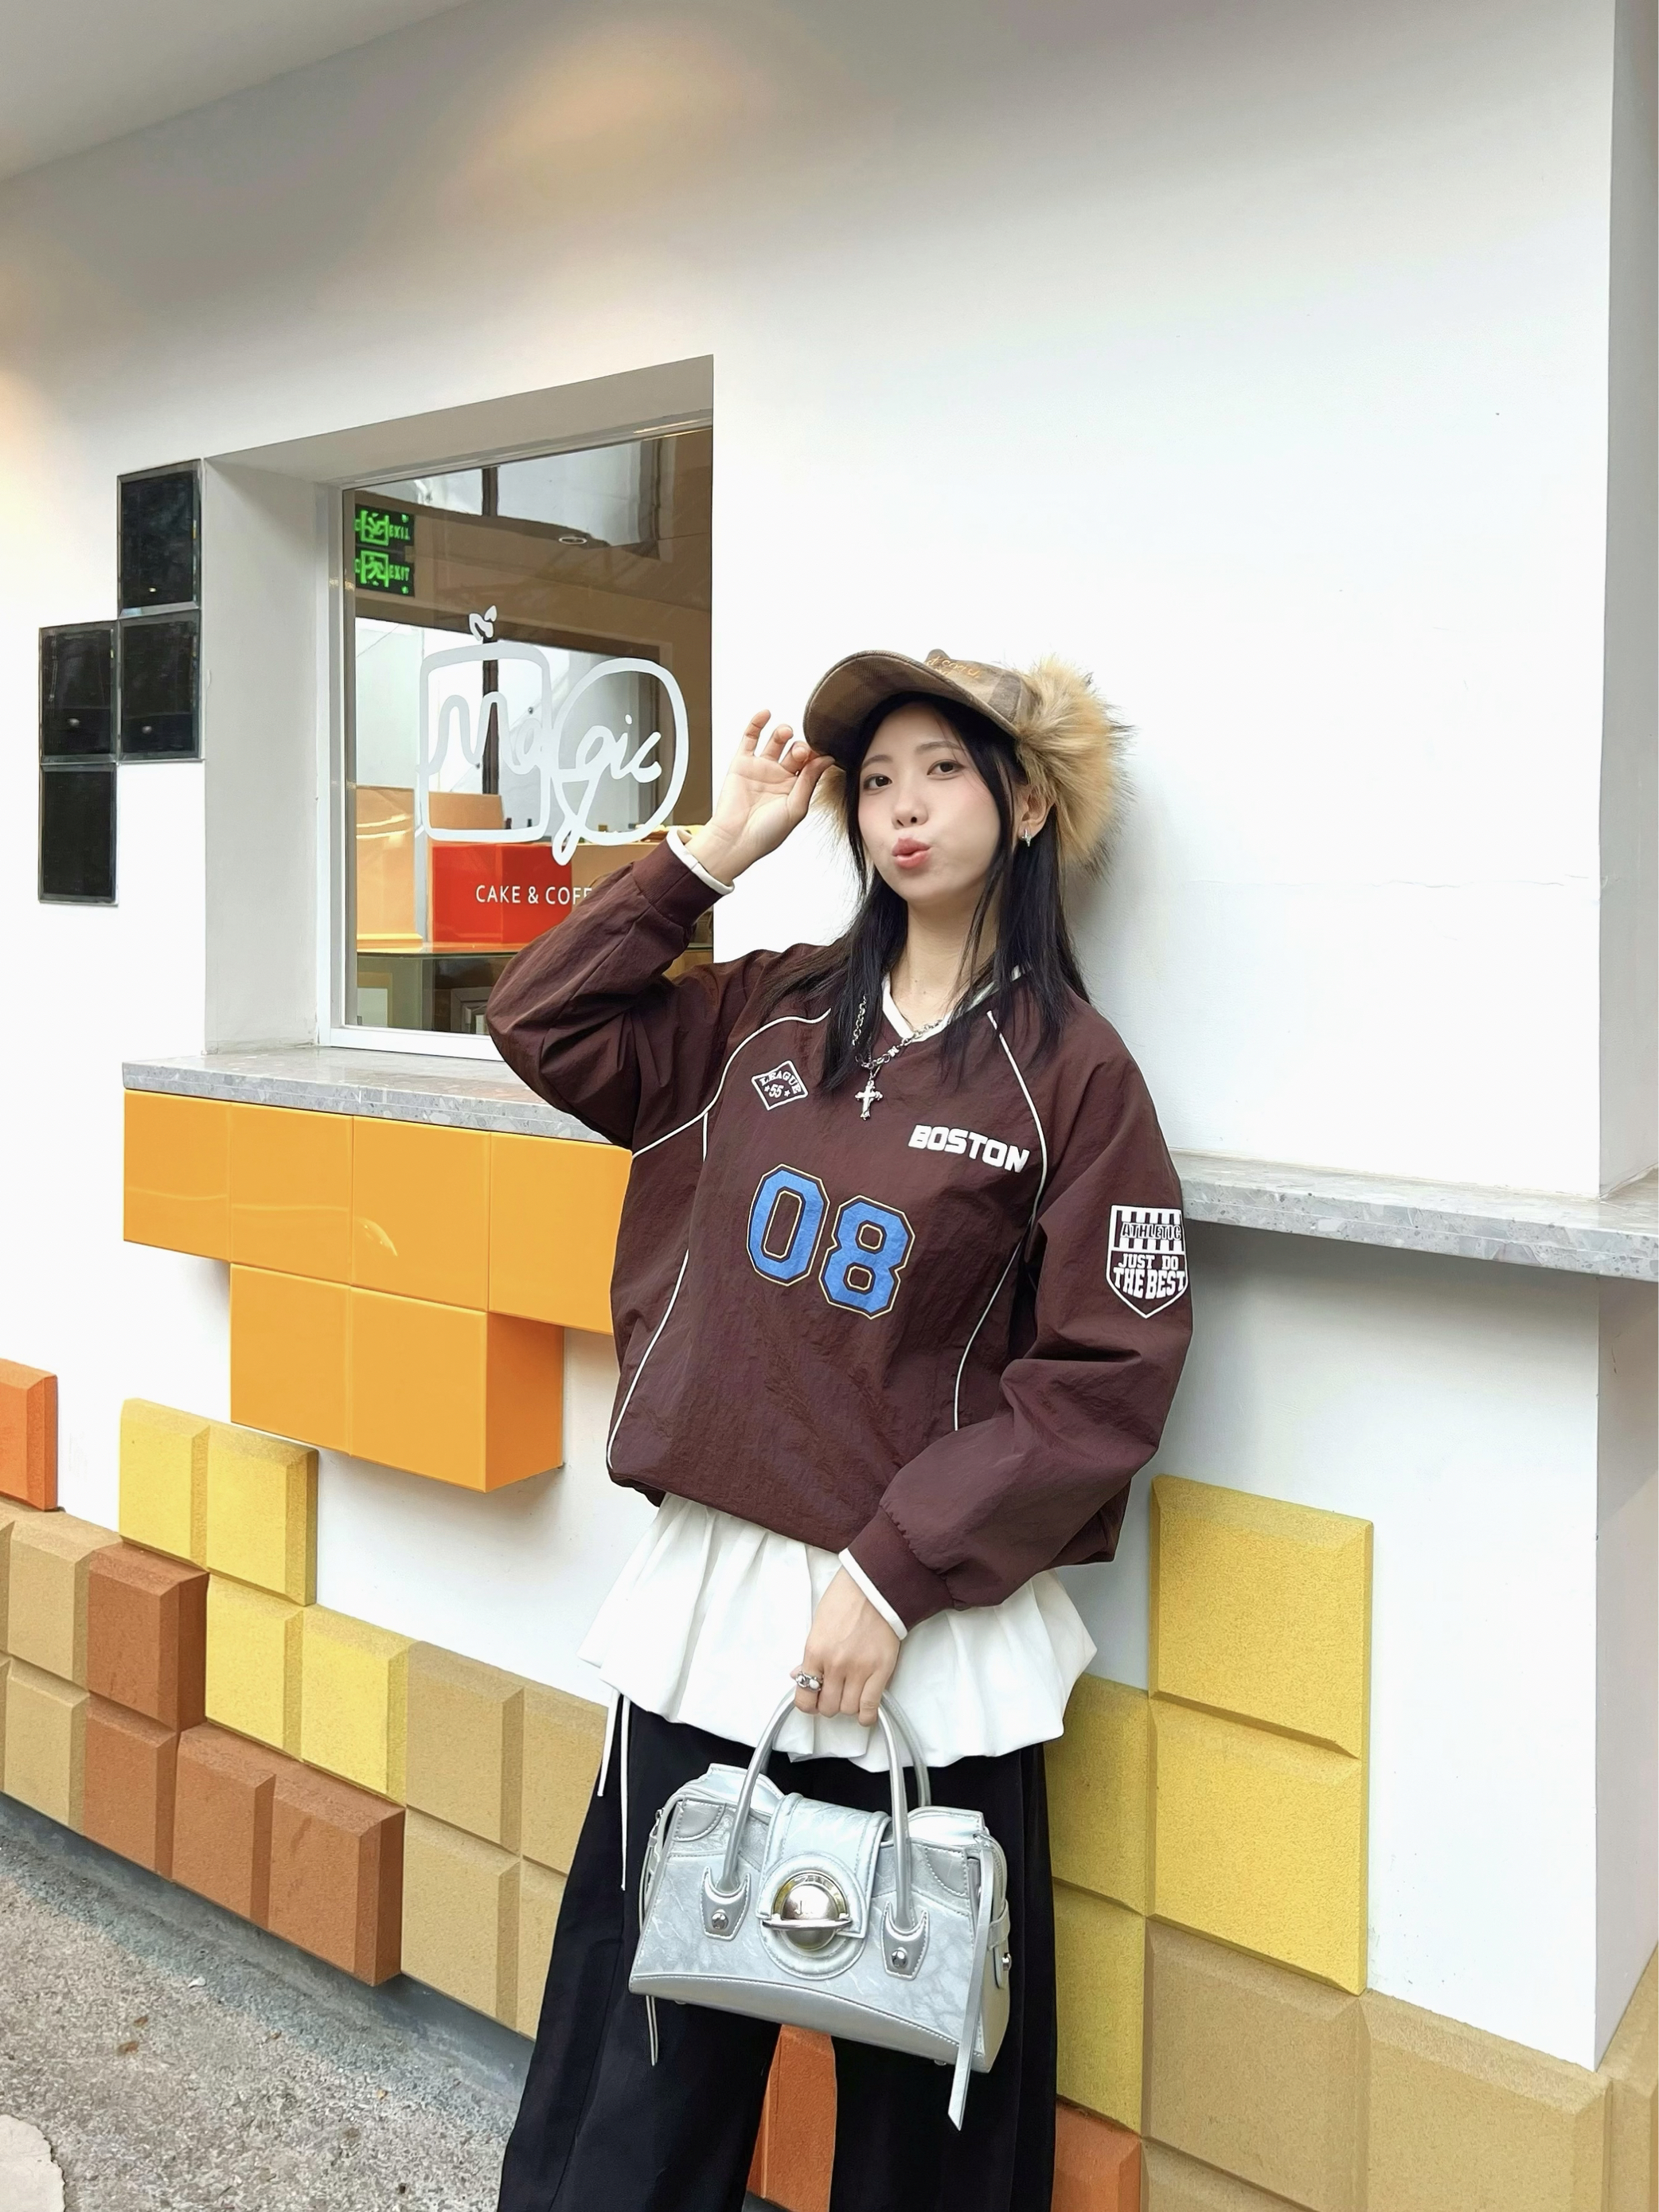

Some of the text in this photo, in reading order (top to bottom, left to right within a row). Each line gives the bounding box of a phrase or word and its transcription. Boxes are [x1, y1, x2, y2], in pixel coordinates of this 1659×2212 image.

[389, 565, 410, 581] EXIT
[476, 885, 521, 904] CAKE
[528, 886, 539, 905] &
[759, 1070, 802, 1095] LEAGUE
[768, 1084, 784, 1098] 55
[908, 1124, 1030, 1174] BOSTON
[746, 1163, 915, 1319] 08
[1120, 1222, 1182, 1240] ATHLETIC
[1118, 1253, 1179, 1270] JUST DO
[1113, 1267, 1185, 1299] THE BEST
